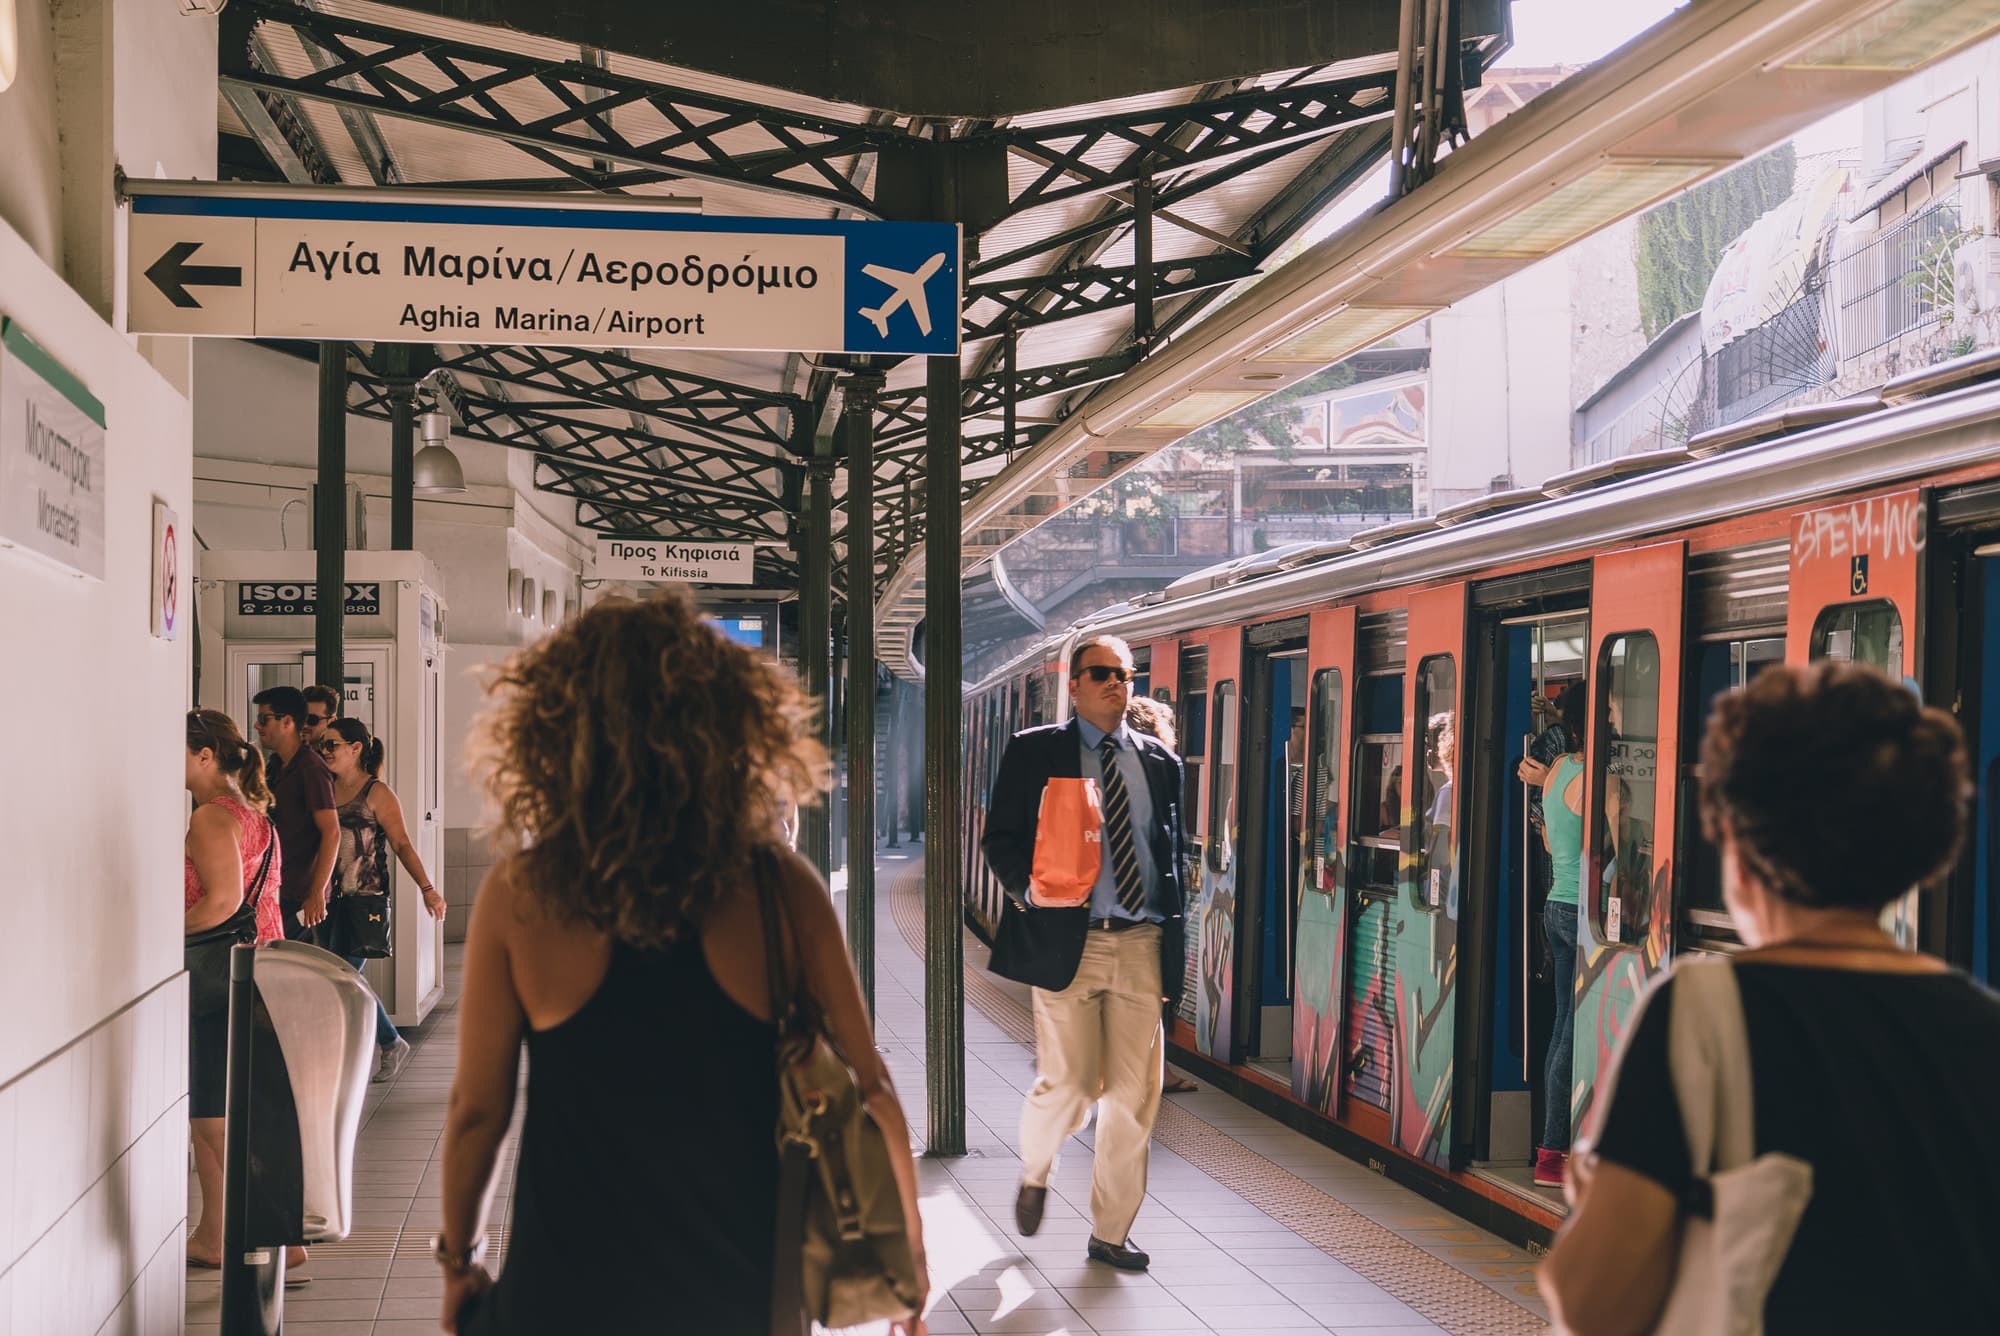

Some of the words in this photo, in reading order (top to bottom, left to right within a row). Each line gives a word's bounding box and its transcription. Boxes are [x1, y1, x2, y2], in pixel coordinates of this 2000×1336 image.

[288, 241, 381, 281] Αγία
[399, 303, 480, 332] Aghia
[610, 543, 656, 561] Προς
[665, 545, 740, 563] Κηφισιά
[640, 565, 655, 576] To
[660, 566, 708, 579] Kifissia
[263, 605, 294, 613] 210
